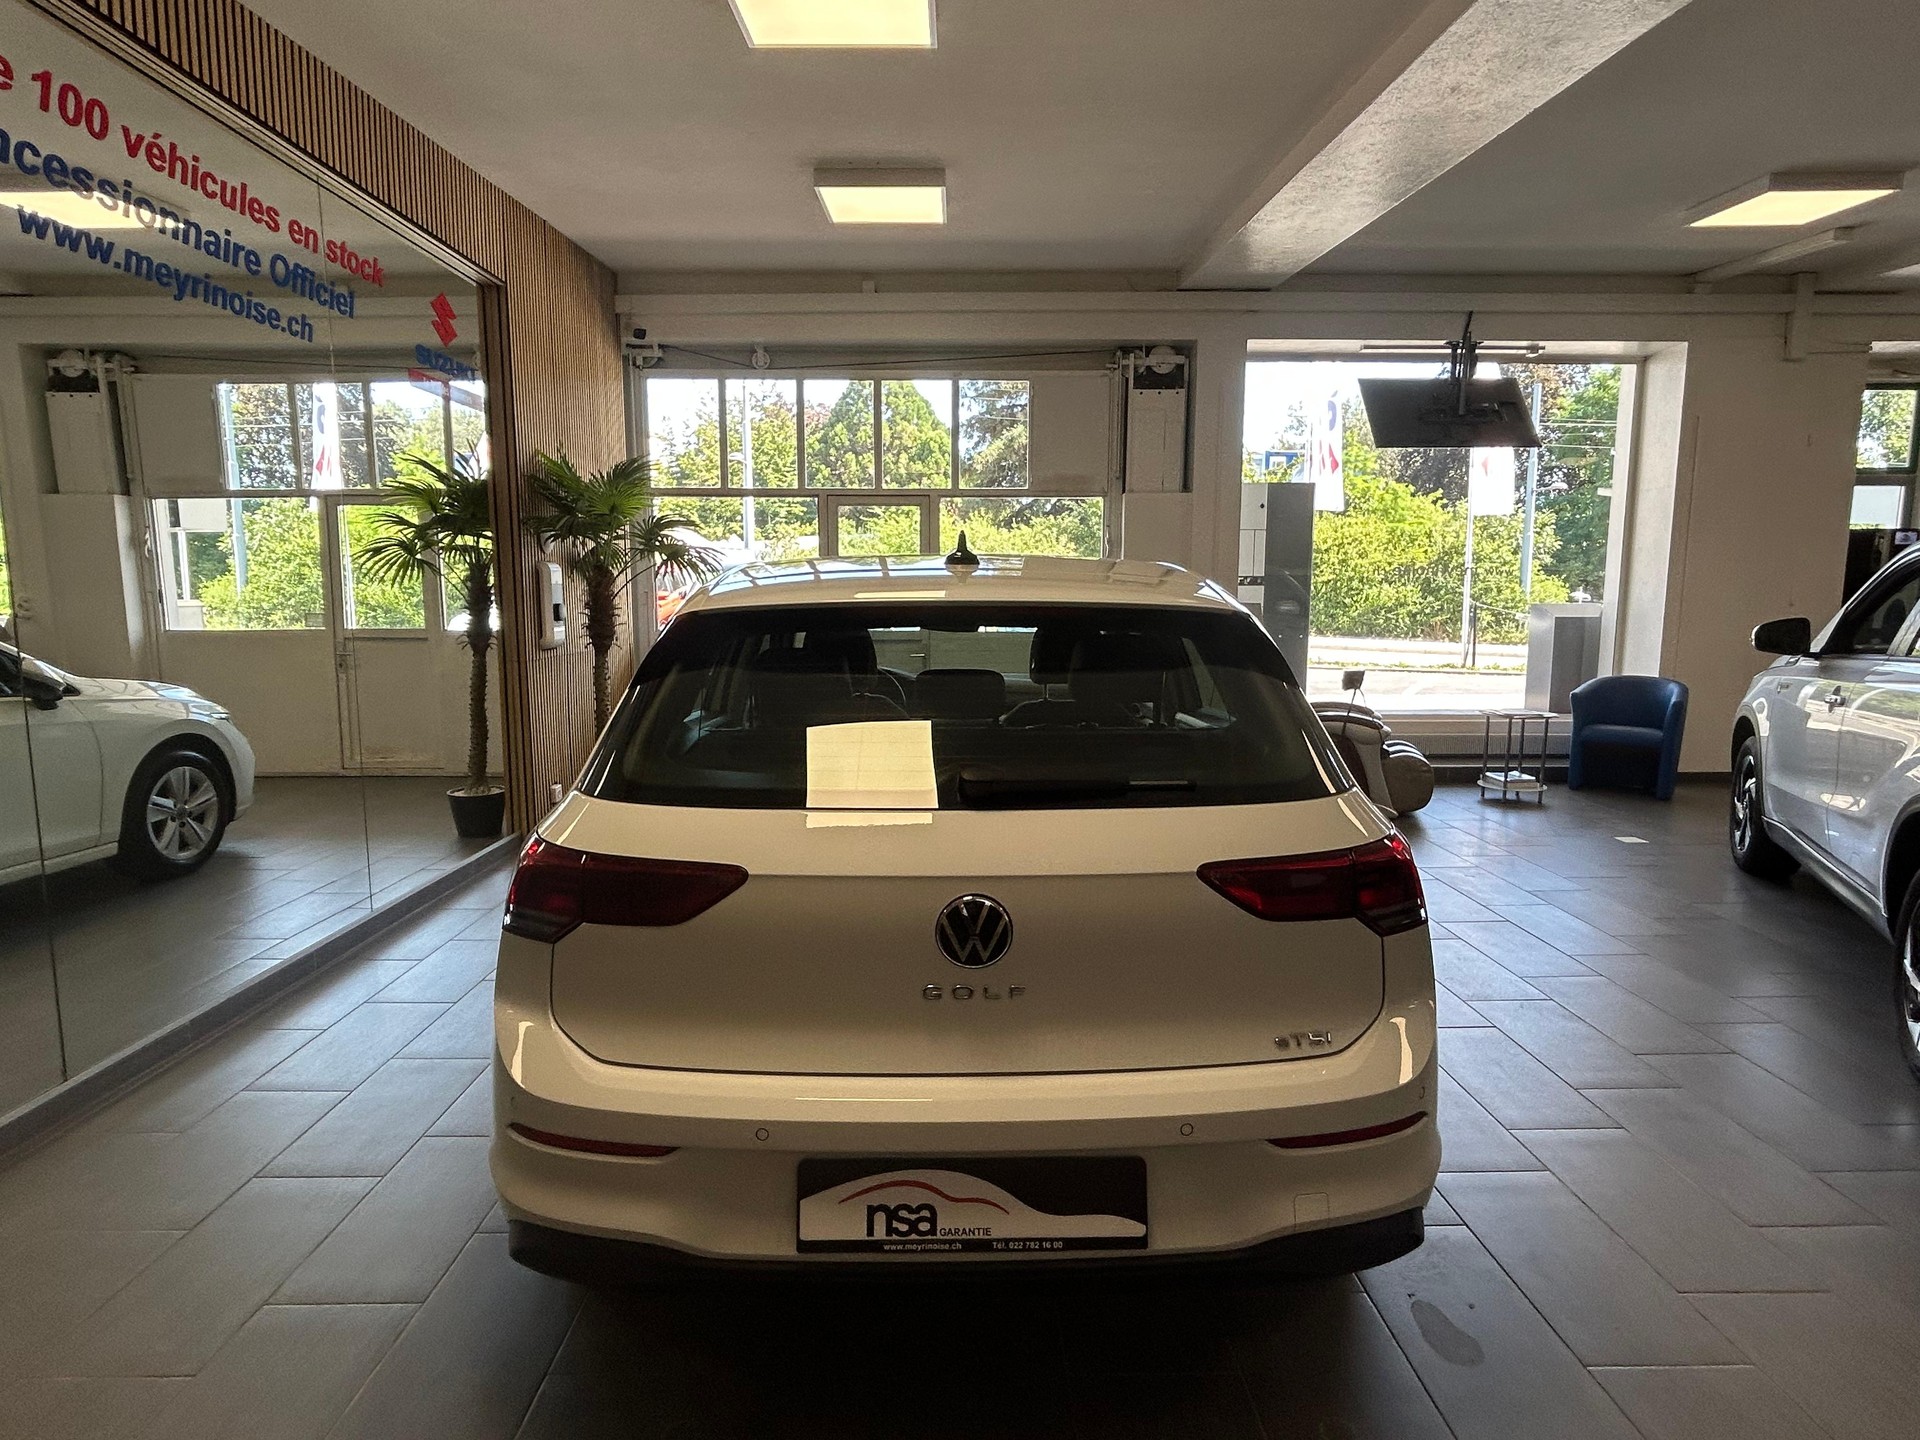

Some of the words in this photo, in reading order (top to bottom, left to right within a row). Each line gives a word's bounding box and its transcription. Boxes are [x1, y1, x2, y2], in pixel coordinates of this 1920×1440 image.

[32, 70, 109, 140] 100
[121, 125, 281, 233] véhicules
[288, 219, 319, 254] en
[326, 236, 384, 287] stock
[17, 205, 314, 343] www.meyrinoise.ch
[269, 254, 355, 319] Officiel
[922, 984, 1026, 1000] GOLF
[866, 1203, 938, 1238] nsa
[939, 1227, 992, 1238] GARANTIE
[883, 1242, 962, 1251] www.meyrinoise.ch
[1008, 1240, 1024, 1250] 022
[1025, 1240, 1040, 1250] 782
[1042, 1240, 1052, 1250] 16
[1053, 1240, 1064, 1250] 00
